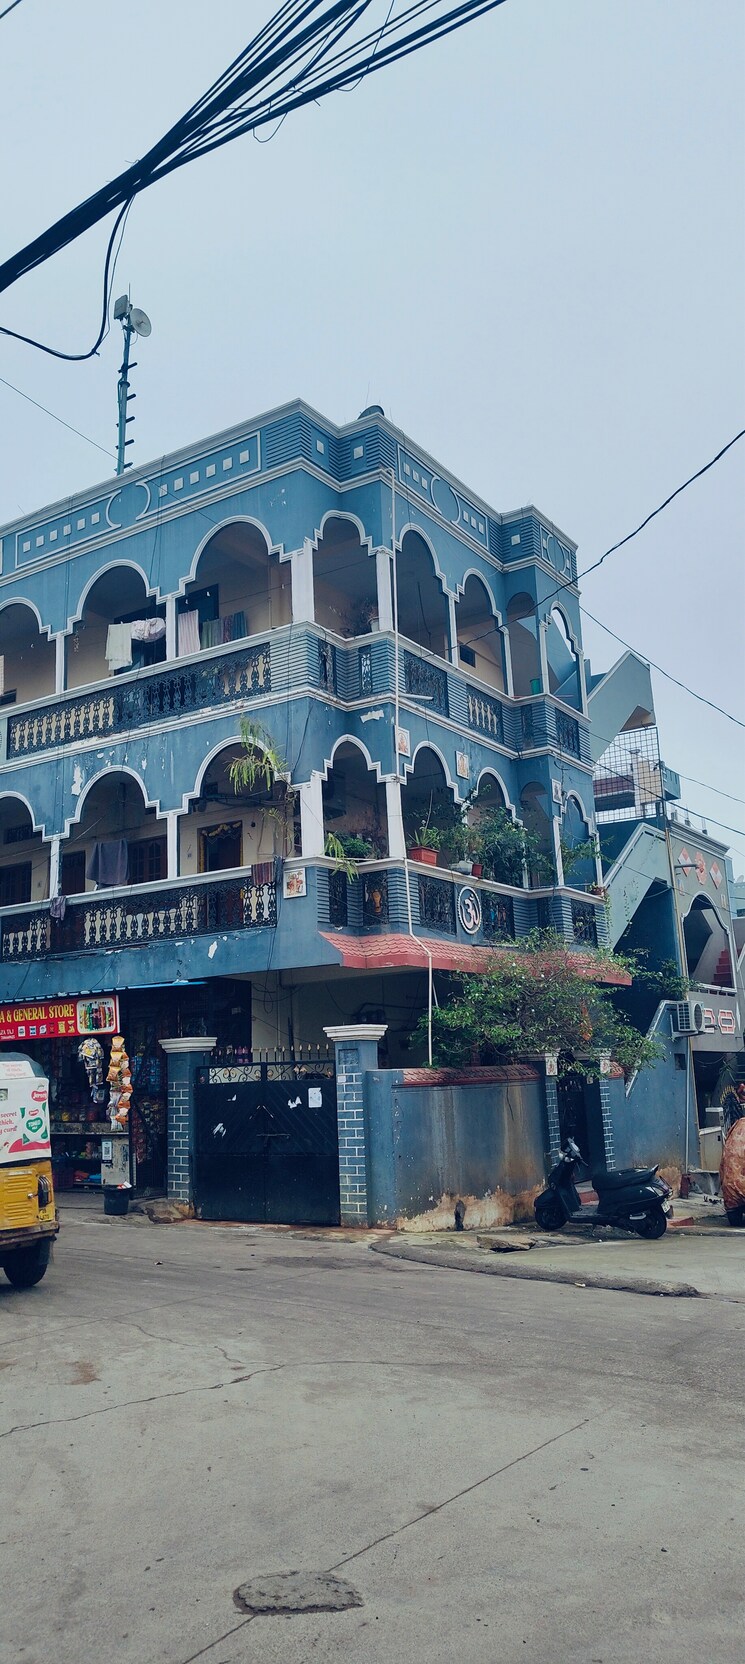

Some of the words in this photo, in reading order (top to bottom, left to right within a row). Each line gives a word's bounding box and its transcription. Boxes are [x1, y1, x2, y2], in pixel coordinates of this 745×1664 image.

[6, 1010, 12, 1023] &
[13, 1006, 48, 1022] GENERAL
[48, 1003, 75, 1019] STORE
